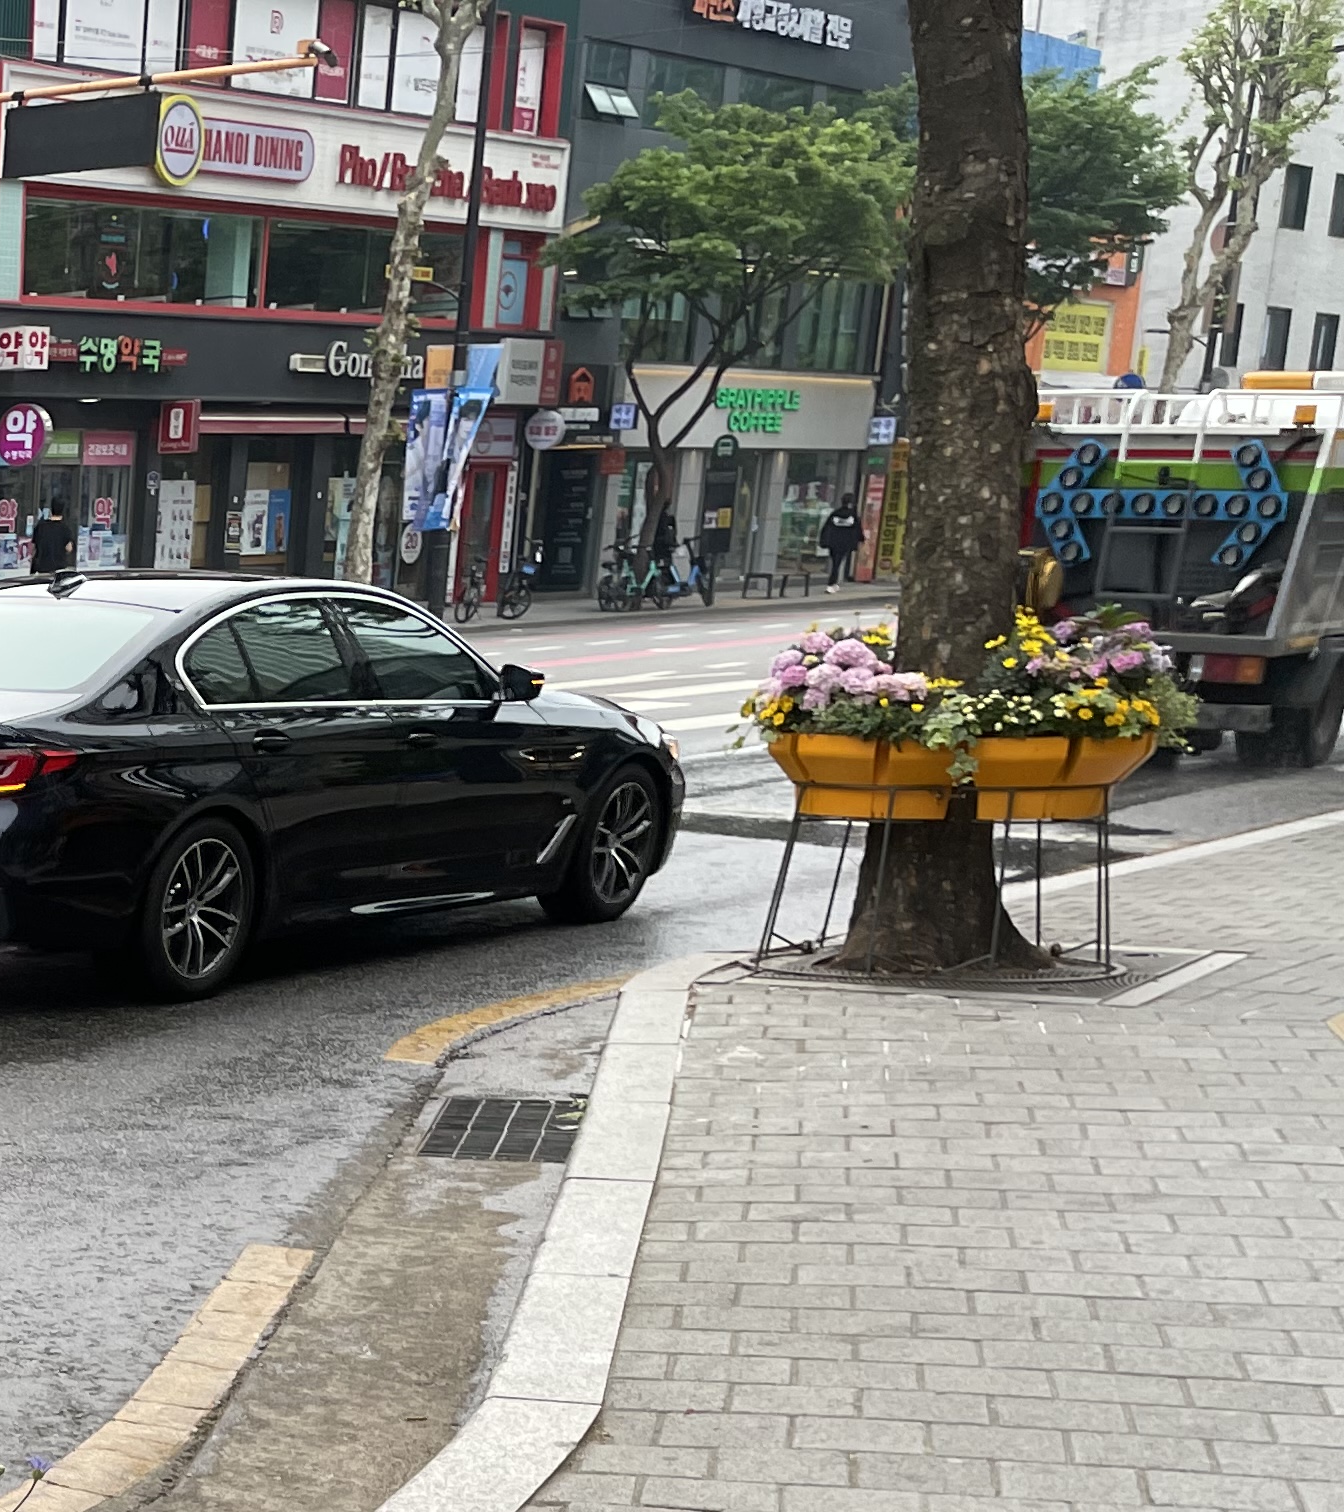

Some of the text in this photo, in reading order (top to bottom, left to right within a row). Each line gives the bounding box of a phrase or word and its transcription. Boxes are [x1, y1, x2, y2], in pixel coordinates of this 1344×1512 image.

[204, 129, 249, 166] HANOI
[253, 135, 304, 172] DINING
[28, 330, 48, 365] 약
[78, 335, 163, 373] 수명약국
[6, 410, 37, 449] 약
[727, 411, 783, 433] COFFEE
